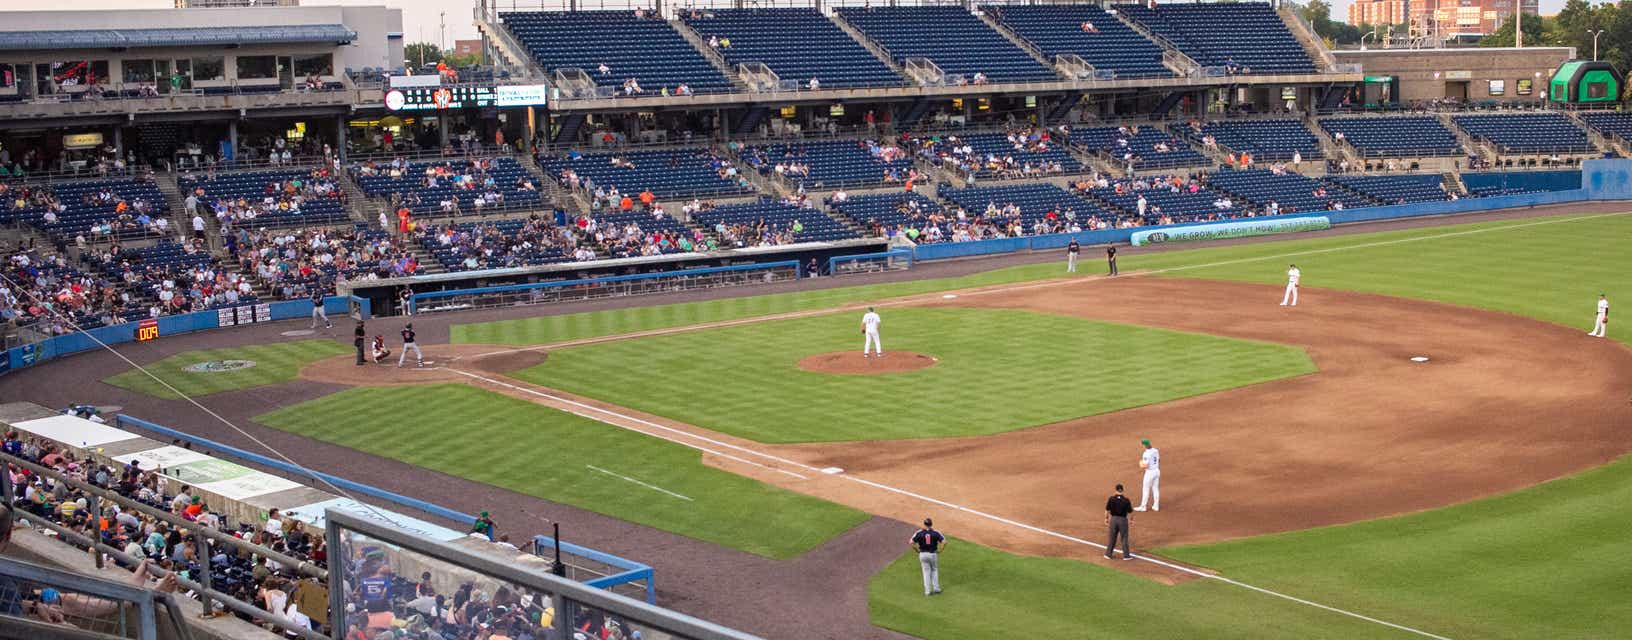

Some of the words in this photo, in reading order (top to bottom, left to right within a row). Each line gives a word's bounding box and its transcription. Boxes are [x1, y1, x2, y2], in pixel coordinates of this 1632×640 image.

[1174, 232, 1187, 240] WE
[1217, 229, 1228, 237] WE
[139, 326, 159, 341] 009
